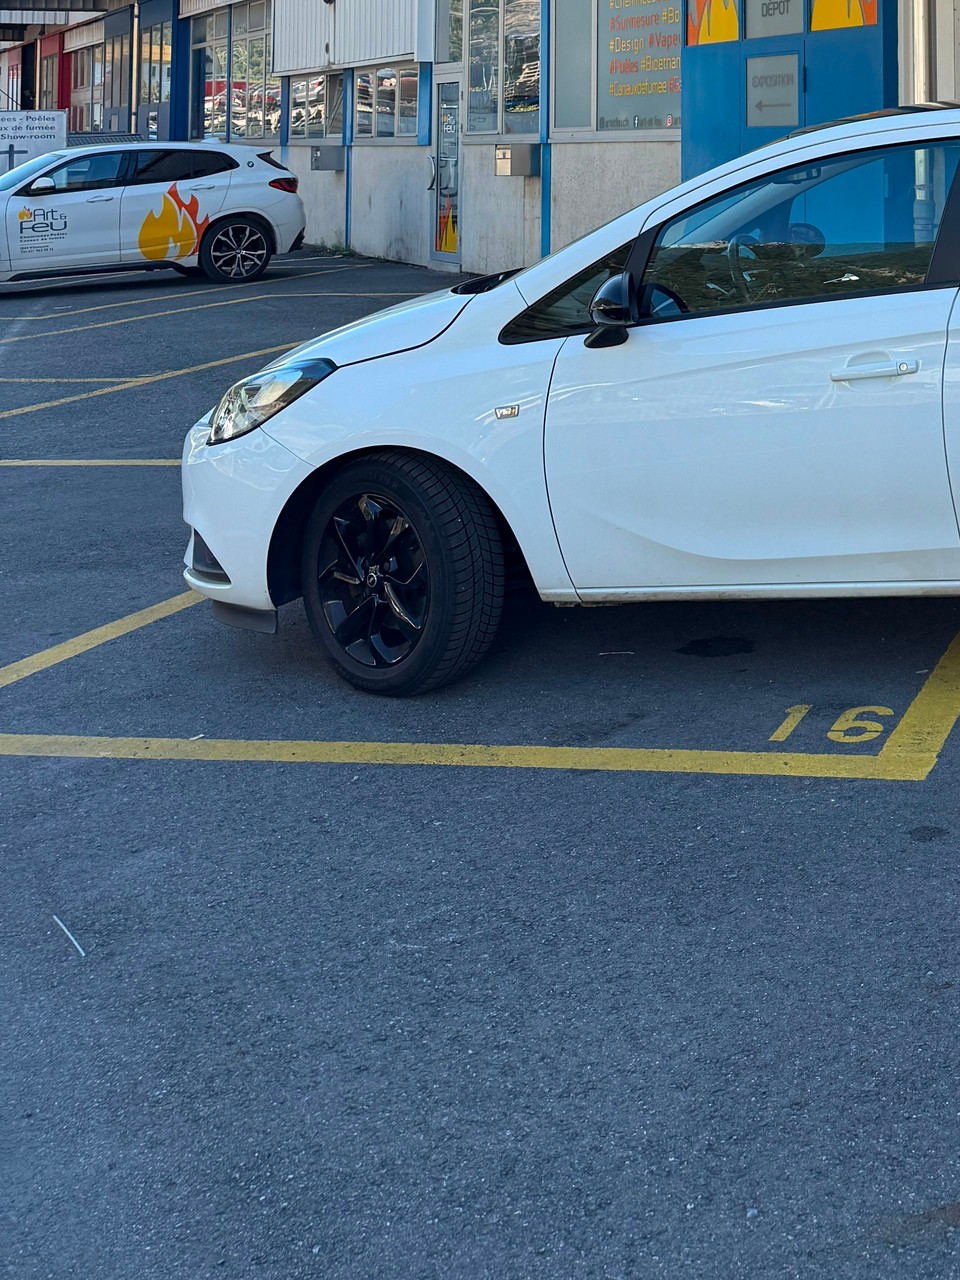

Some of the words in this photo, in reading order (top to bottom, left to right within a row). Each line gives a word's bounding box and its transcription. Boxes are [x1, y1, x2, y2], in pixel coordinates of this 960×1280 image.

[609, 37, 644, 54] #Design
[33, 208, 58, 221] Art
[768, 704, 894, 743] 16
